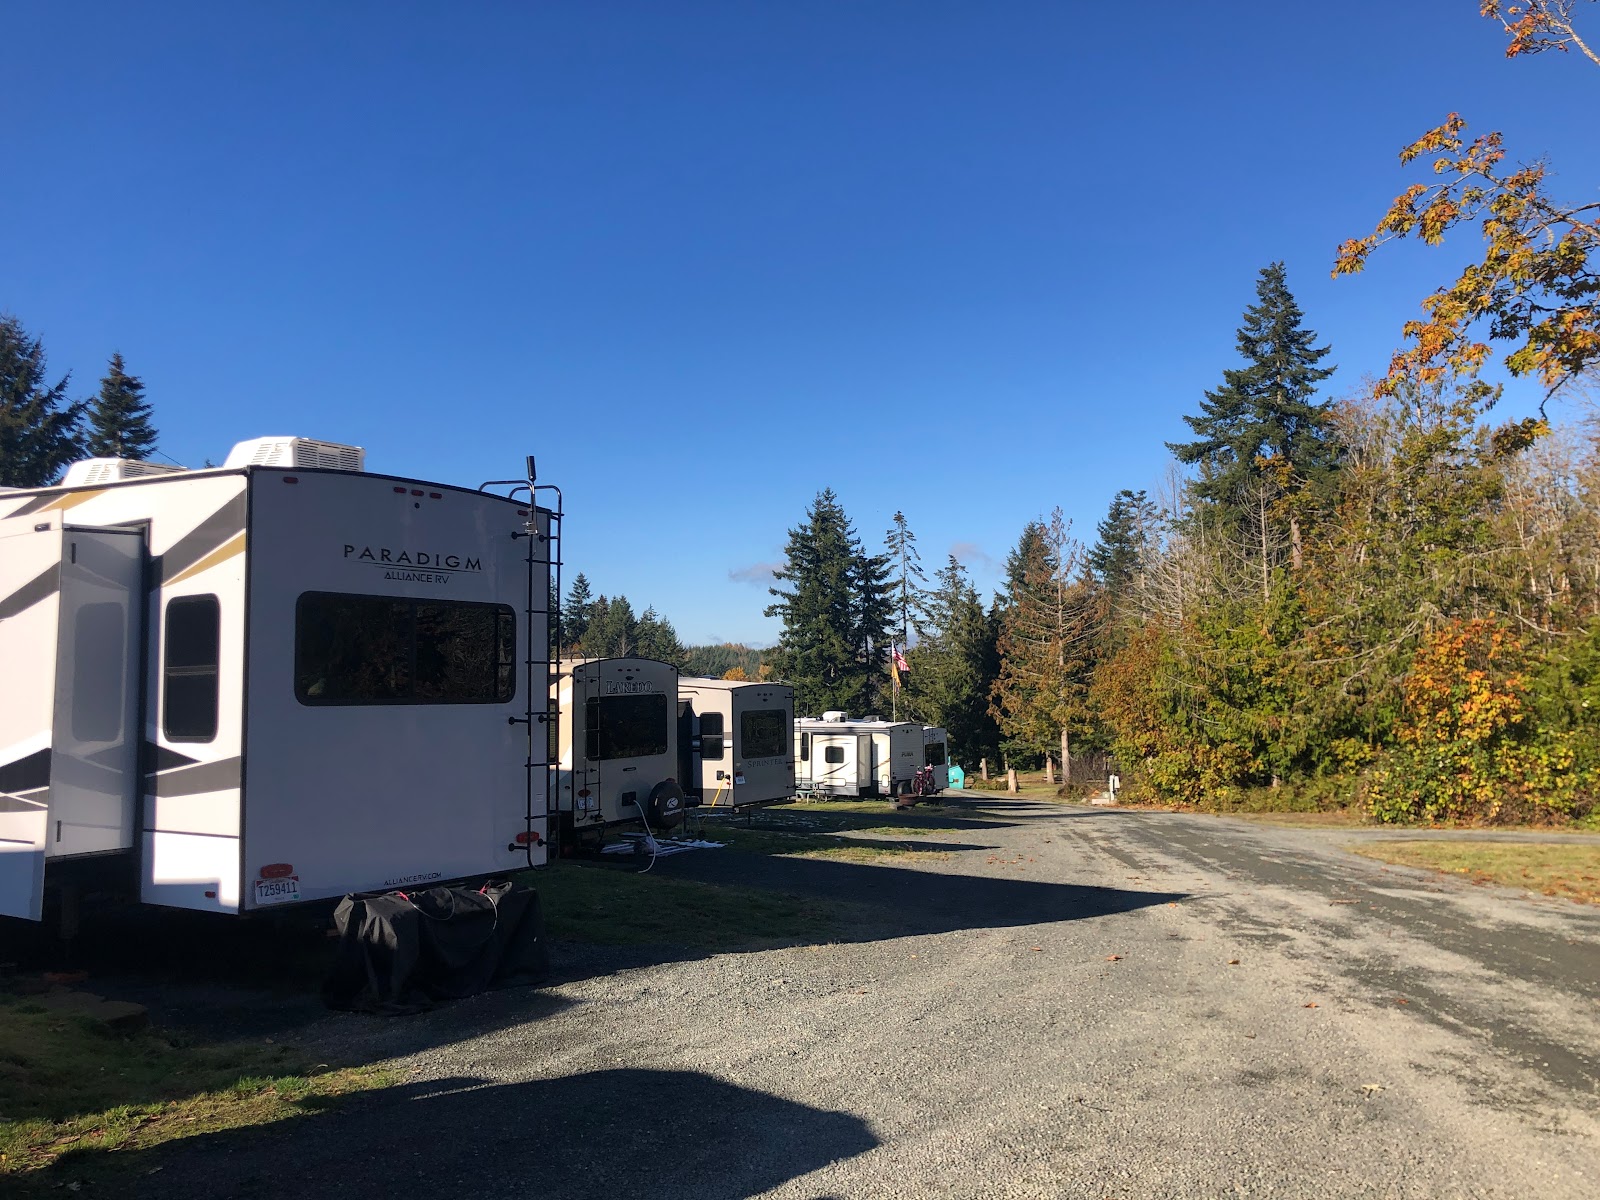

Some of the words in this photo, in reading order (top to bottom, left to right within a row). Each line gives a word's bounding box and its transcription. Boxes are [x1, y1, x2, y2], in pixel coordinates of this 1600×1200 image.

[344, 544, 482, 570] PARADIGM
[384, 572, 433, 583] ALLIANCE
[435, 575, 450, 584] RV
[606, 680, 653, 695] LAREDO
[747, 758, 783, 768] SPRINTER
[383, 872, 442, 886] ALLIANCERV.COM
[259, 881, 297, 897] T259411
